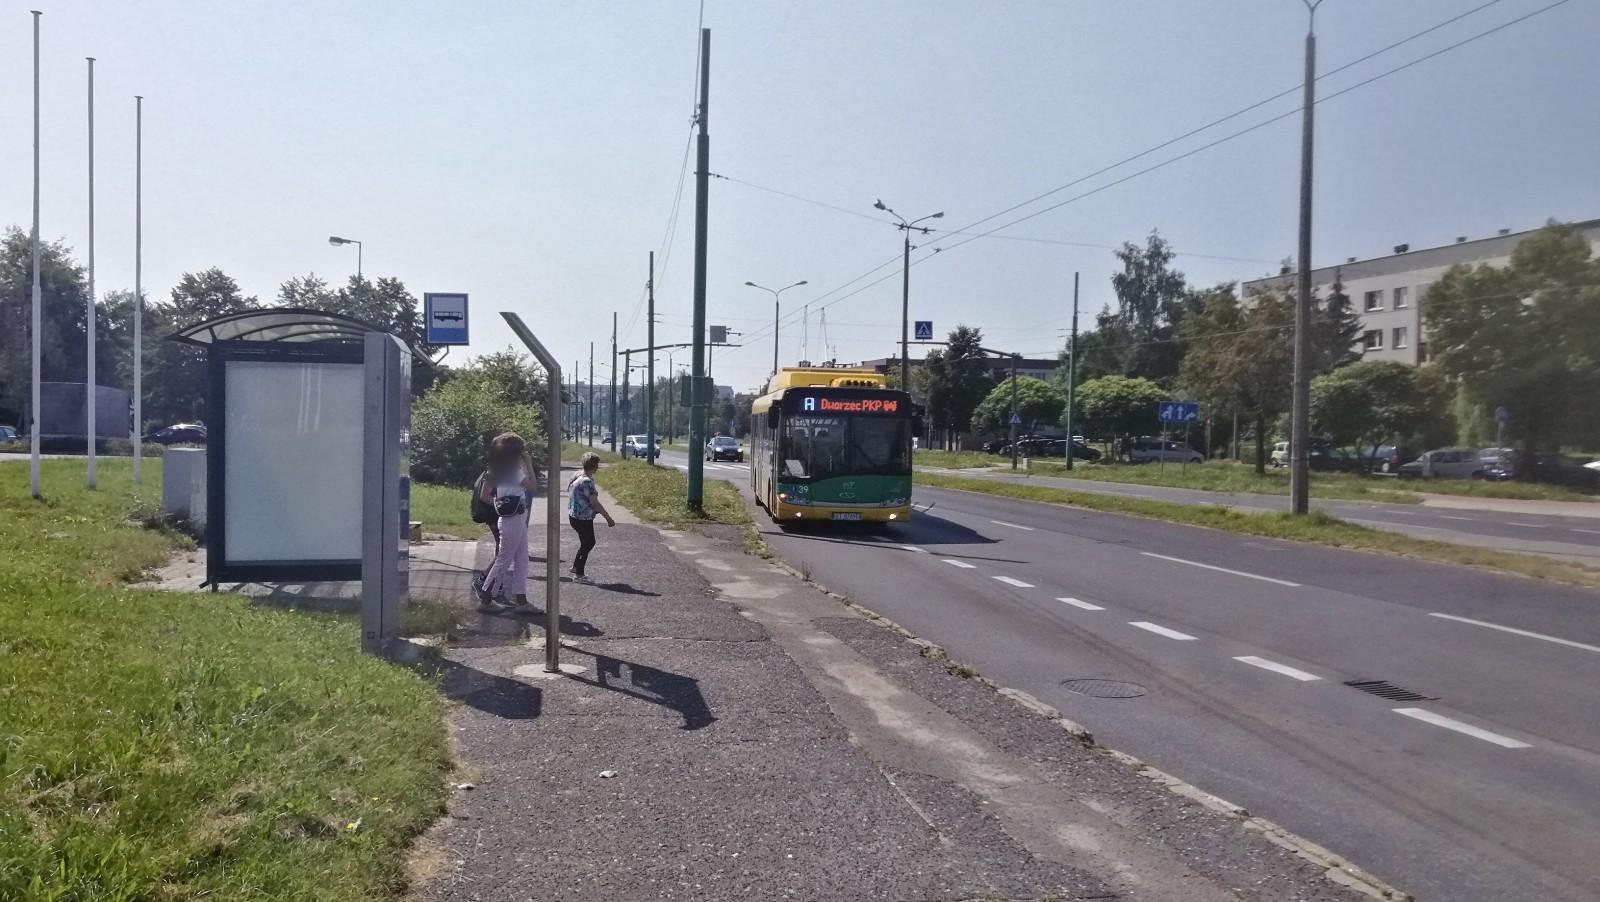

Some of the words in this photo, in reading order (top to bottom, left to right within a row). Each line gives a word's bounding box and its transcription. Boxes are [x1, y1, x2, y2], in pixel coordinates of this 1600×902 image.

[804, 397, 815, 410] A
[821, 398, 861, 411] Dworzec
[862, 400, 882, 411] PKP
[798, 485, 809, 494] 39
